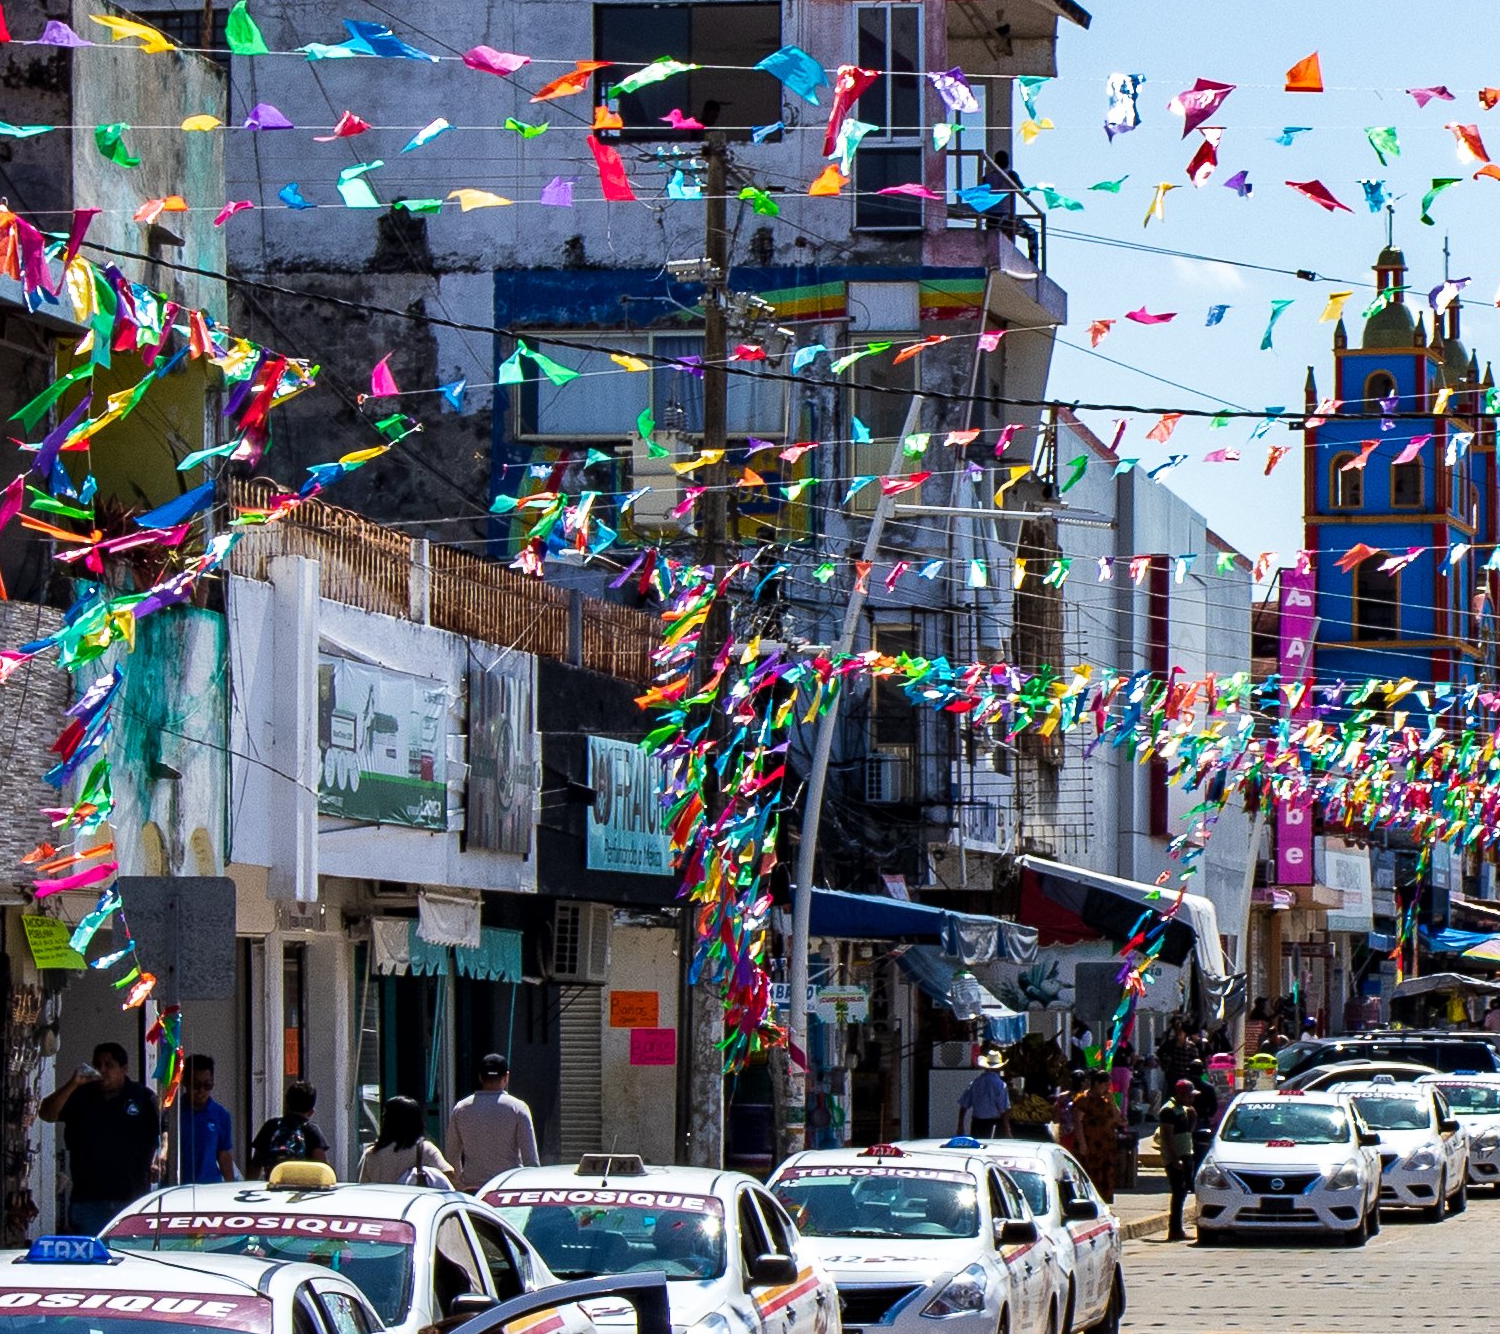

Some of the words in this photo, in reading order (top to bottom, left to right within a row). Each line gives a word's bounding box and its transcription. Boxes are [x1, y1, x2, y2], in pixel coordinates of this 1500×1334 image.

[871, 1147, 897, 1156] TAXI
[589, 1160, 636, 1172] TAXI
[795, 1167, 956, 1181] TENOSIQUE
[498, 1190, 705, 1211] TENOSIQUE
[146, 1216, 384, 1237] TENOSIQUE
[39, 1240, 94, 1259] TAXI
